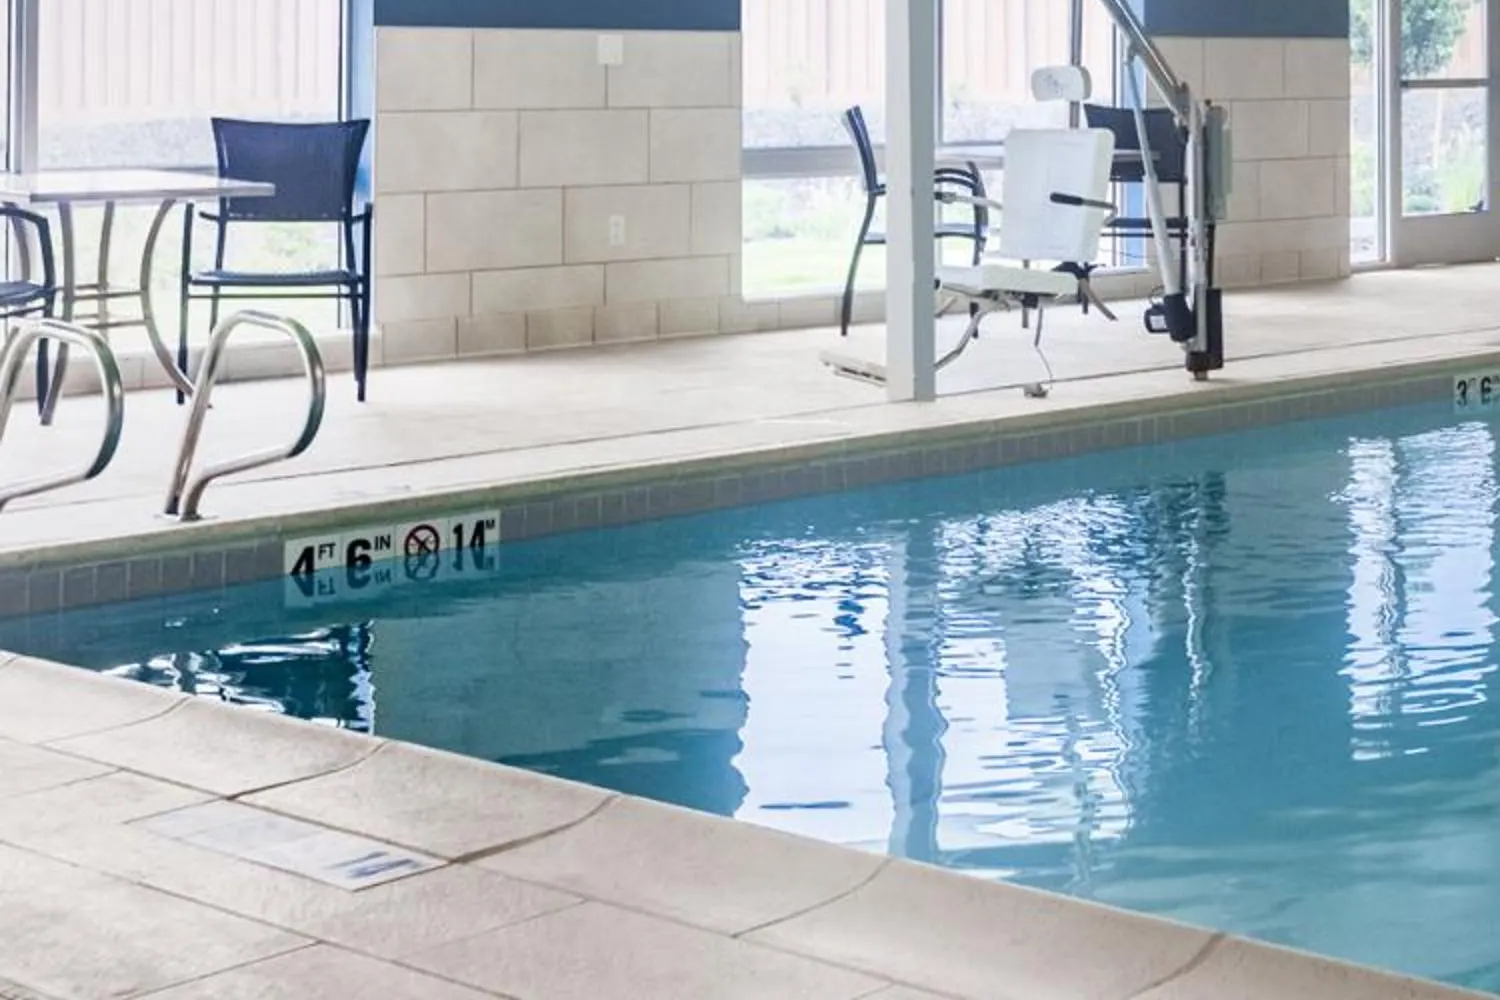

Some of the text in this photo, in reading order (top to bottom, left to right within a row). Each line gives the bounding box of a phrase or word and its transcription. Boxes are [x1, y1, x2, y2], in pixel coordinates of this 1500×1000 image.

[318, 542, 336, 560] FT
[346, 538, 373, 569] 6
[374, 534, 391, 551] IN
